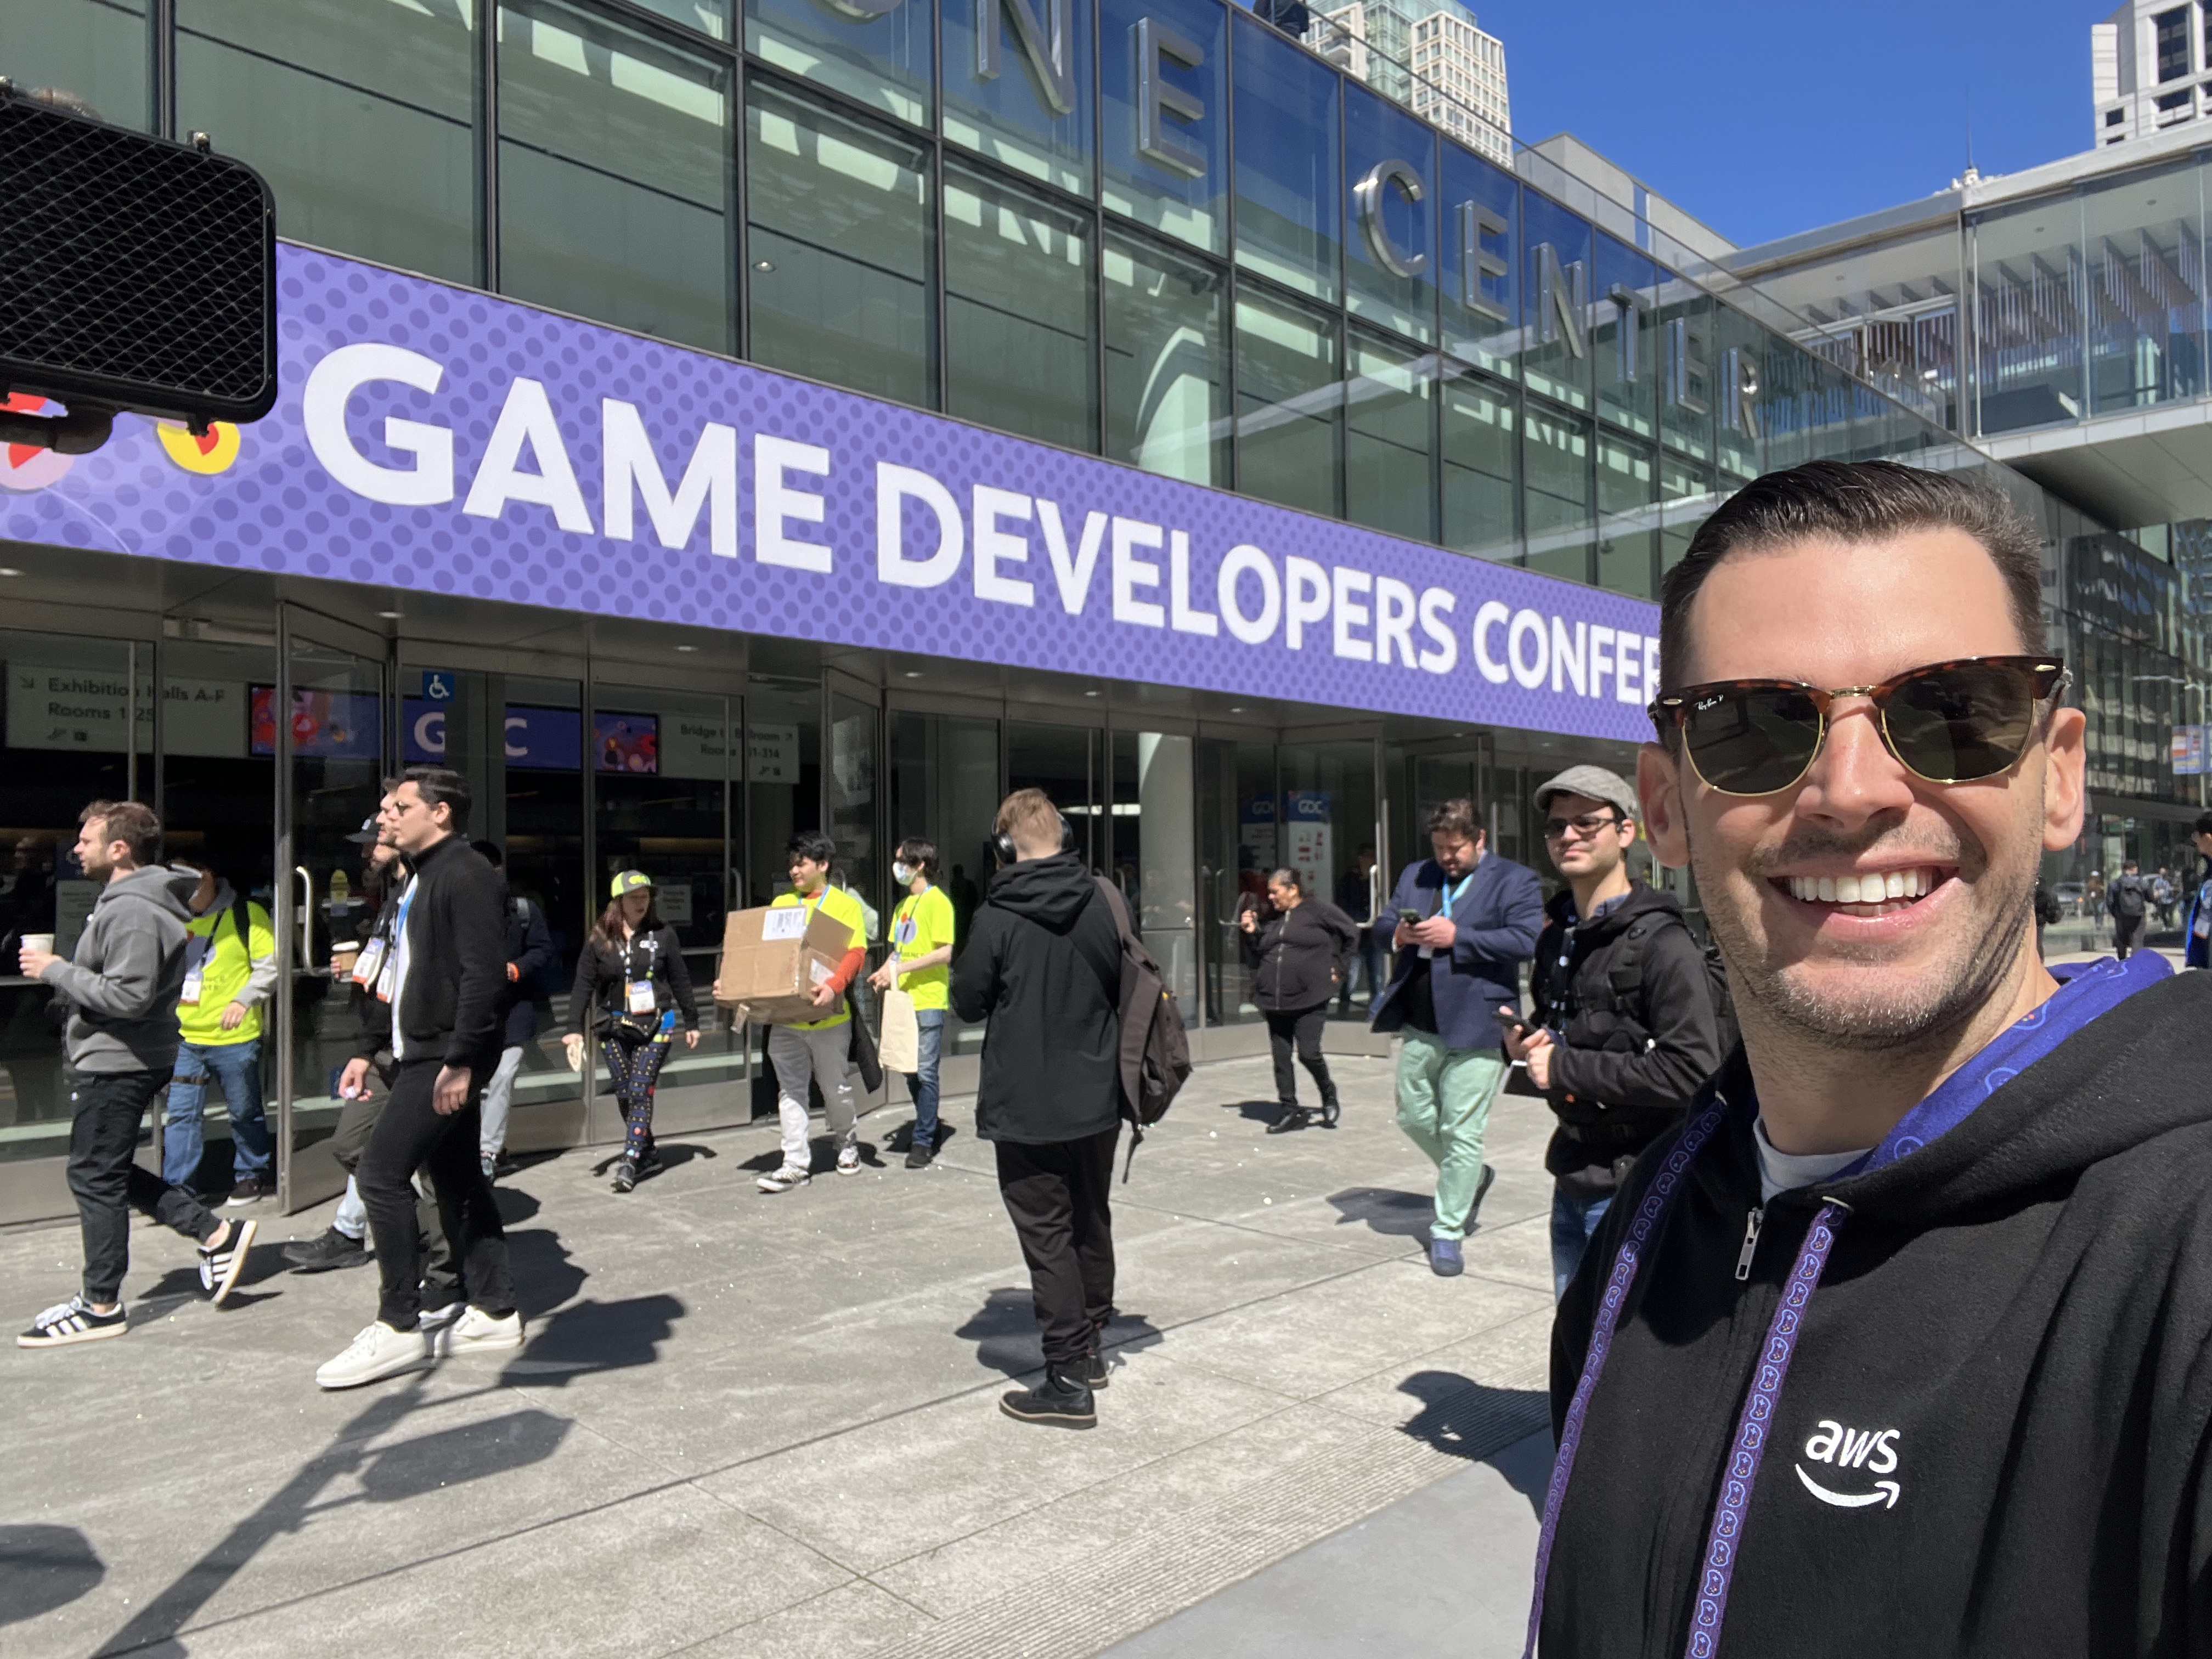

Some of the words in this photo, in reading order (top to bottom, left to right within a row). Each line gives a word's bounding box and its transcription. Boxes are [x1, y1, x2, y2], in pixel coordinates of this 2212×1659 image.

[1354, 159, 1758, 439] CENTER
[303, 342, 832, 574] GAME
[876, 461, 1458, 674] DEVELOPERS
[48, 702, 110, 719] Rooms
[414, 712, 528, 757] GC
[1298, 799, 1323, 814] GDC
[1805, 1420, 1900, 1474] aws
